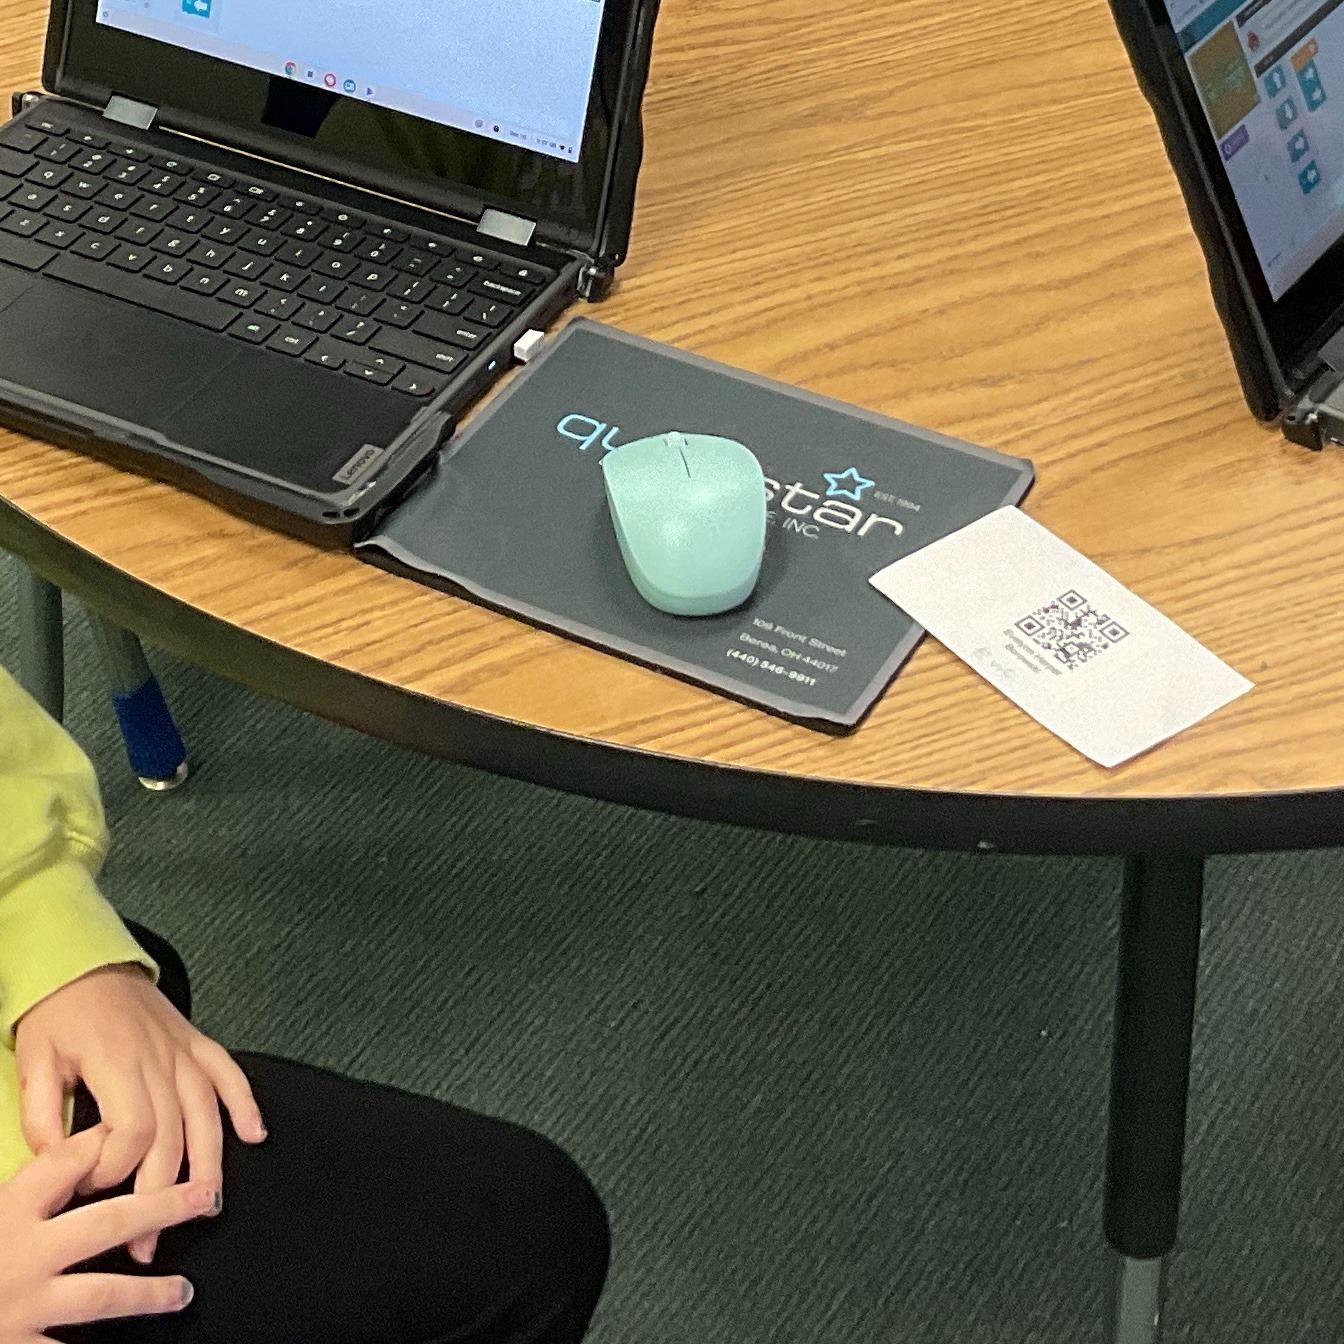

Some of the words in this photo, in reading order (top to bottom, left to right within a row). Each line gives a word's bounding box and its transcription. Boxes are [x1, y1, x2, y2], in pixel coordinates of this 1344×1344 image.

[774, 625, 807, 643] Front
[808, 637, 847, 657] Street
[726, 648, 760, 667] (440)
